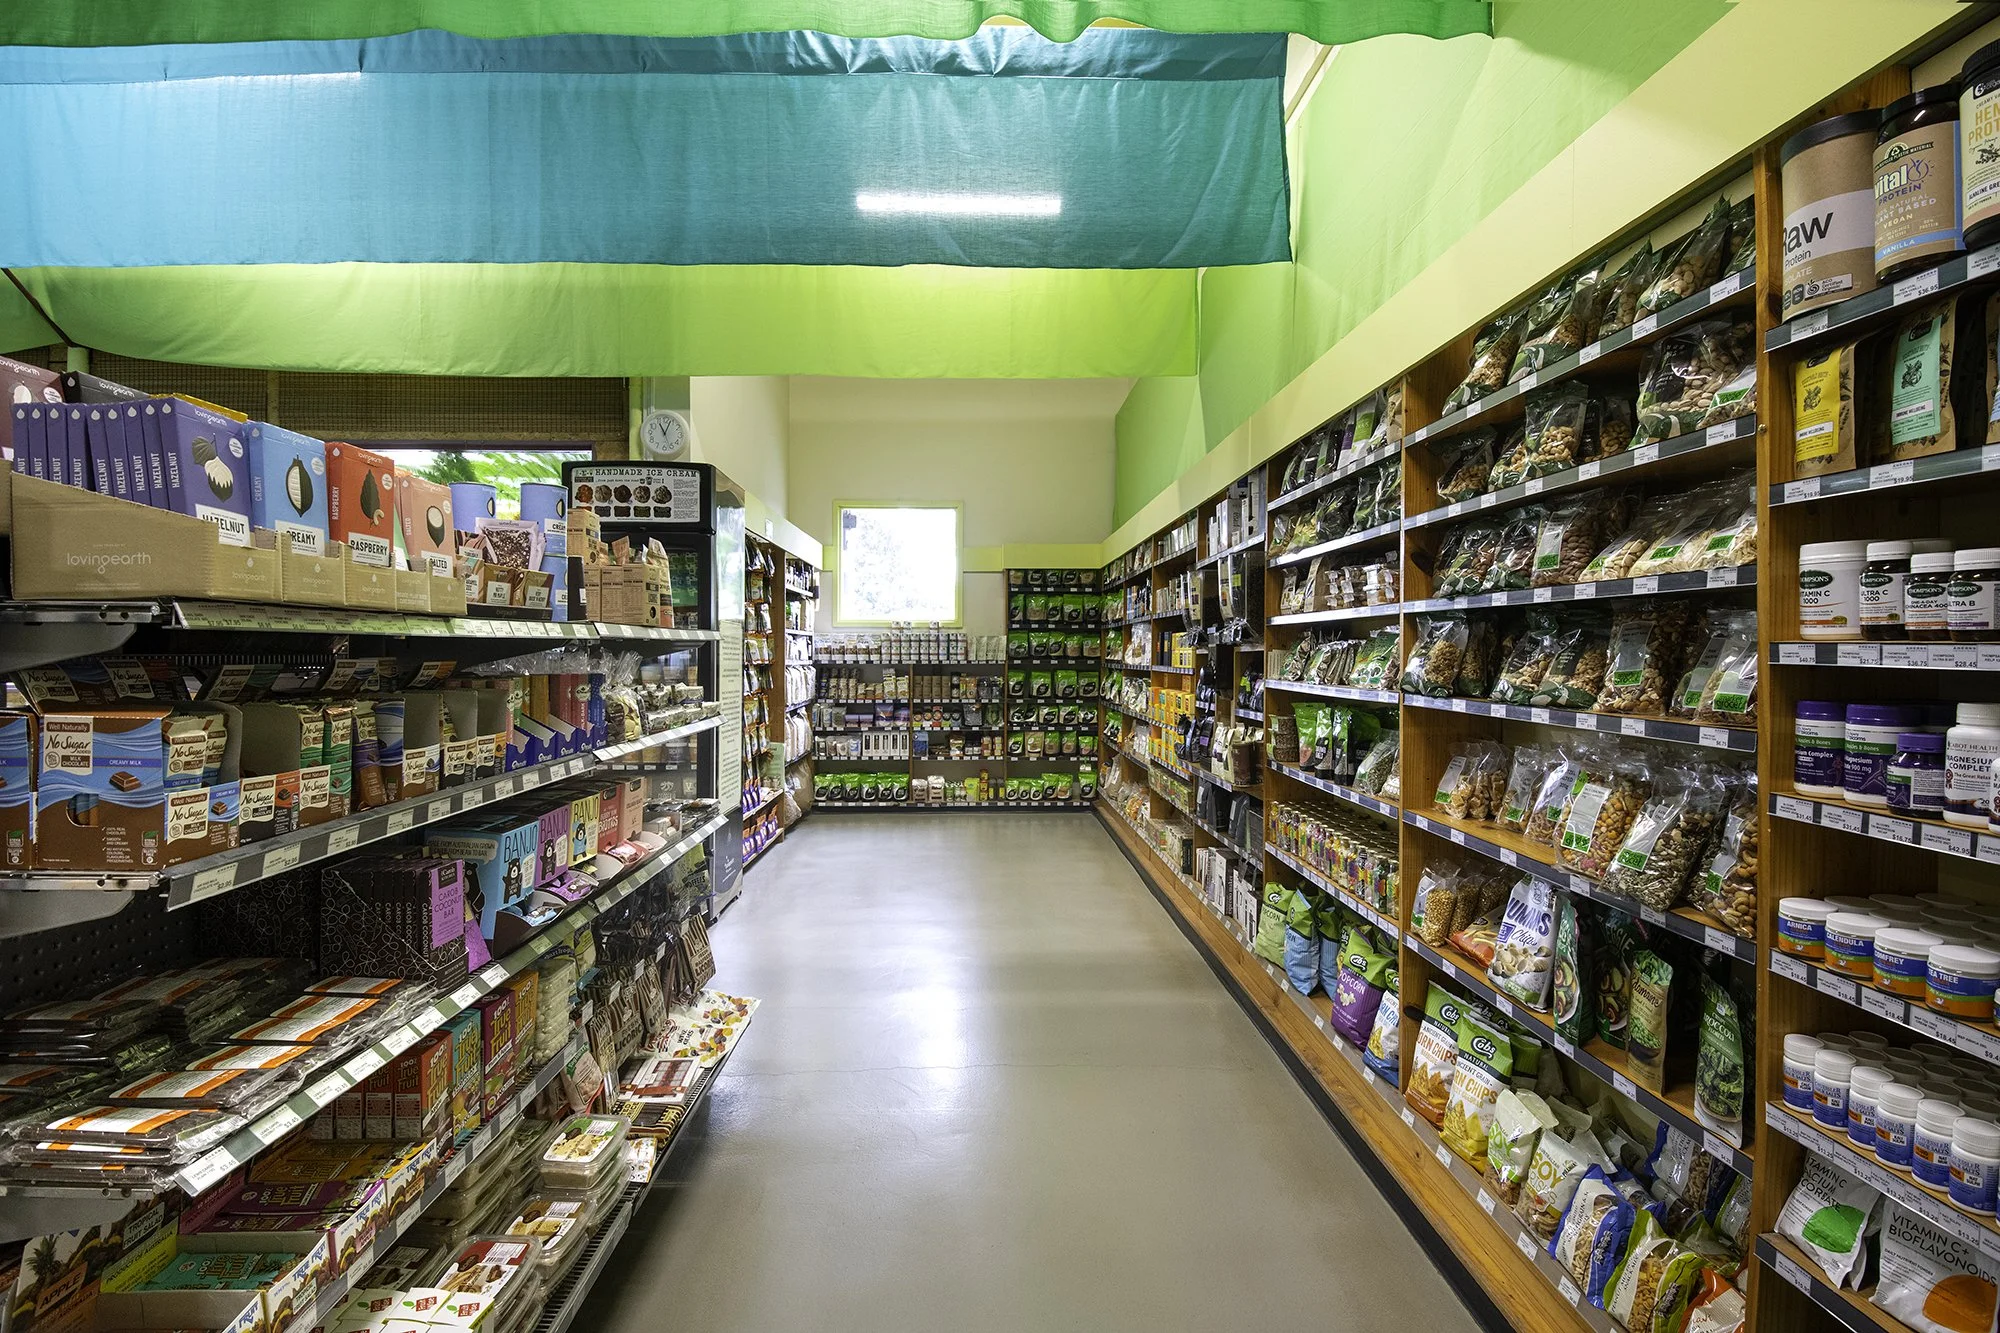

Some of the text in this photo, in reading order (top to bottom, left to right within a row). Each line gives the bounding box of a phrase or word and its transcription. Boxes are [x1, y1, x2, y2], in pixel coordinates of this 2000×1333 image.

[1874, 164, 1908, 200] vital
[1878, 183, 1922, 206] PROTEIN
[1890, 194, 1928, 210] NATURAL
[1898, 198, 1936, 214] BASED
[1884, 213, 1913, 229] VEGAN
[1882, 240, 1915, 255] VANILLA
[1784, 250, 1812, 268] Protein
[1918, 284, 1938, 296] $36.95
[195, 408, 228, 426] lovingearth
[115, 458, 126, 494] HAZELNUT
[133, 456, 145, 491] HAZELNUT
[151, 453, 163, 489] HAZELNUT
[168, 452, 180, 488] HAZELNUT
[1894, 476, 1914, 484] $19.95
[332, 486, 340, 520] RASPBERRY
[350, 540, 388, 556] RASPBERRY
[67, 552, 152, 574] lovingearth
[124, 670, 145, 683] Sugar
[1715, 700, 1743, 712] grocer
[61, 723, 88, 731] Naturally
[45, 734, 91, 753] No Sugar
[170, 746, 184, 759] No
[1969, 742, 1998, 751] HEALTH
[1808, 750, 1834, 759] Complex
[1949, 763, 1991, 772] COMPLET
[300, 780, 328, 794] No Sugar
[186, 795, 206, 803] Naturally
[241, 792, 274, 805] No Sugar
[170, 806, 206, 822] No Sugar
[254, 809, 272, 817] CHOCOLATE
[573, 795, 599, 824] BANJO
[540, 808, 569, 844] BANJO
[504, 824, 538, 863] BANJO
[1948, 846, 1970, 855] $42.95
[434, 894, 462, 913] COCONUT
[439, 887, 458, 902] CAROB
[444, 907, 455, 920] BAR
[1786, 920, 1812, 932] ARNICA
[1510, 929, 1538, 946] Chips
[1826, 932, 1864, 947] CALENDULA
[1874, 950, 1904, 966] COMFREY
[1339, 970, 1366, 995] POPCORN
[1928, 968, 1959, 985] TEA TREE
[494, 997, 510, 1017] 100%
[1440, 1004, 1460, 1025] Cobs
[490, 1007, 511, 1037] True
[490, 1025, 511, 1057] Fruit
[1423, 1026, 1441, 1042] ANCIENT
[1936, 1030, 1956, 1044] $18.45
[458, 1029, 478, 1058] True
[1418, 1032, 1433, 1051] ORN
[1432, 1042, 1457, 1066] CHIPS
[1472, 1036, 1496, 1060] Cobs
[400, 1058, 417, 1068] 100%
[430, 1041, 449, 1067] 100%
[1463, 1053, 1488, 1070] NATURAL
[398, 1066, 419, 1080] True
[428, 1053, 448, 1083] True
[456, 1048, 478, 1085] Fruit
[396, 1077, 419, 1090] Fruit
[1476, 1072, 1490, 1085] GRAIN
[428, 1070, 448, 1110] Fruit
[1466, 1076, 1498, 1104] CHIPS
[1534, 1150, 1563, 1188] SOY
[1807, 1156, 1847, 1188] ITAMIN C
[127, 1208, 158, 1234] TROPICAL
[356, 1202, 370, 1222] TRUE
[124, 1214, 163, 1248] FRUIT SALAD
[1893, 1212, 1947, 1246] VITAMIN
[1958, 1230, 1980, 1246] $13.25
[294, 1241, 326, 1280] TRUE FRUIT
[1889, 1224, 1997, 1288] BIOFLAVONOIDS
[1918, 1264, 1934, 1276] POWDER
[40, 1270, 81, 1310] APPLE
